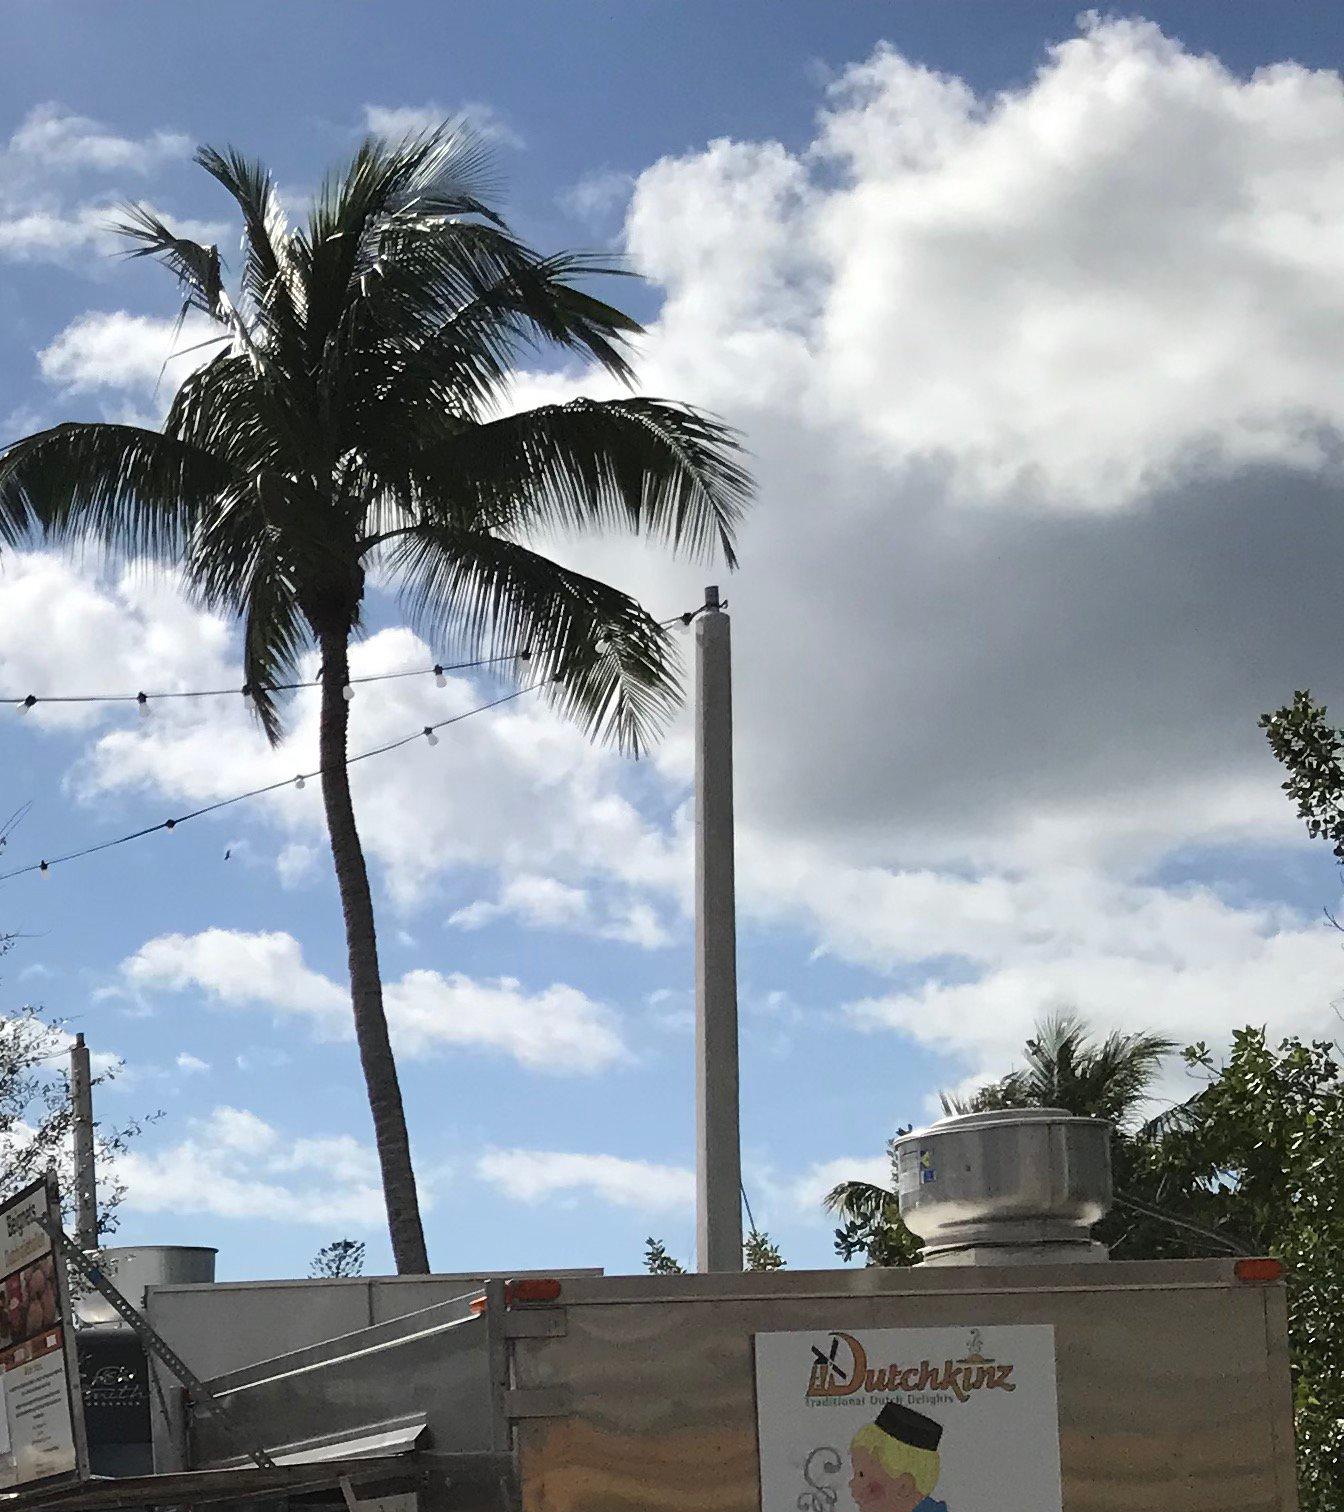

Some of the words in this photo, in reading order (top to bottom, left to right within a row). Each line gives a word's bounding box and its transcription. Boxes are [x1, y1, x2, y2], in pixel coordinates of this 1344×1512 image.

[806, 1332, 1016, 1402] Dutchkinz
[806, 1396, 865, 1407] Traditional
[907, 1393, 954, 1405] Delights
